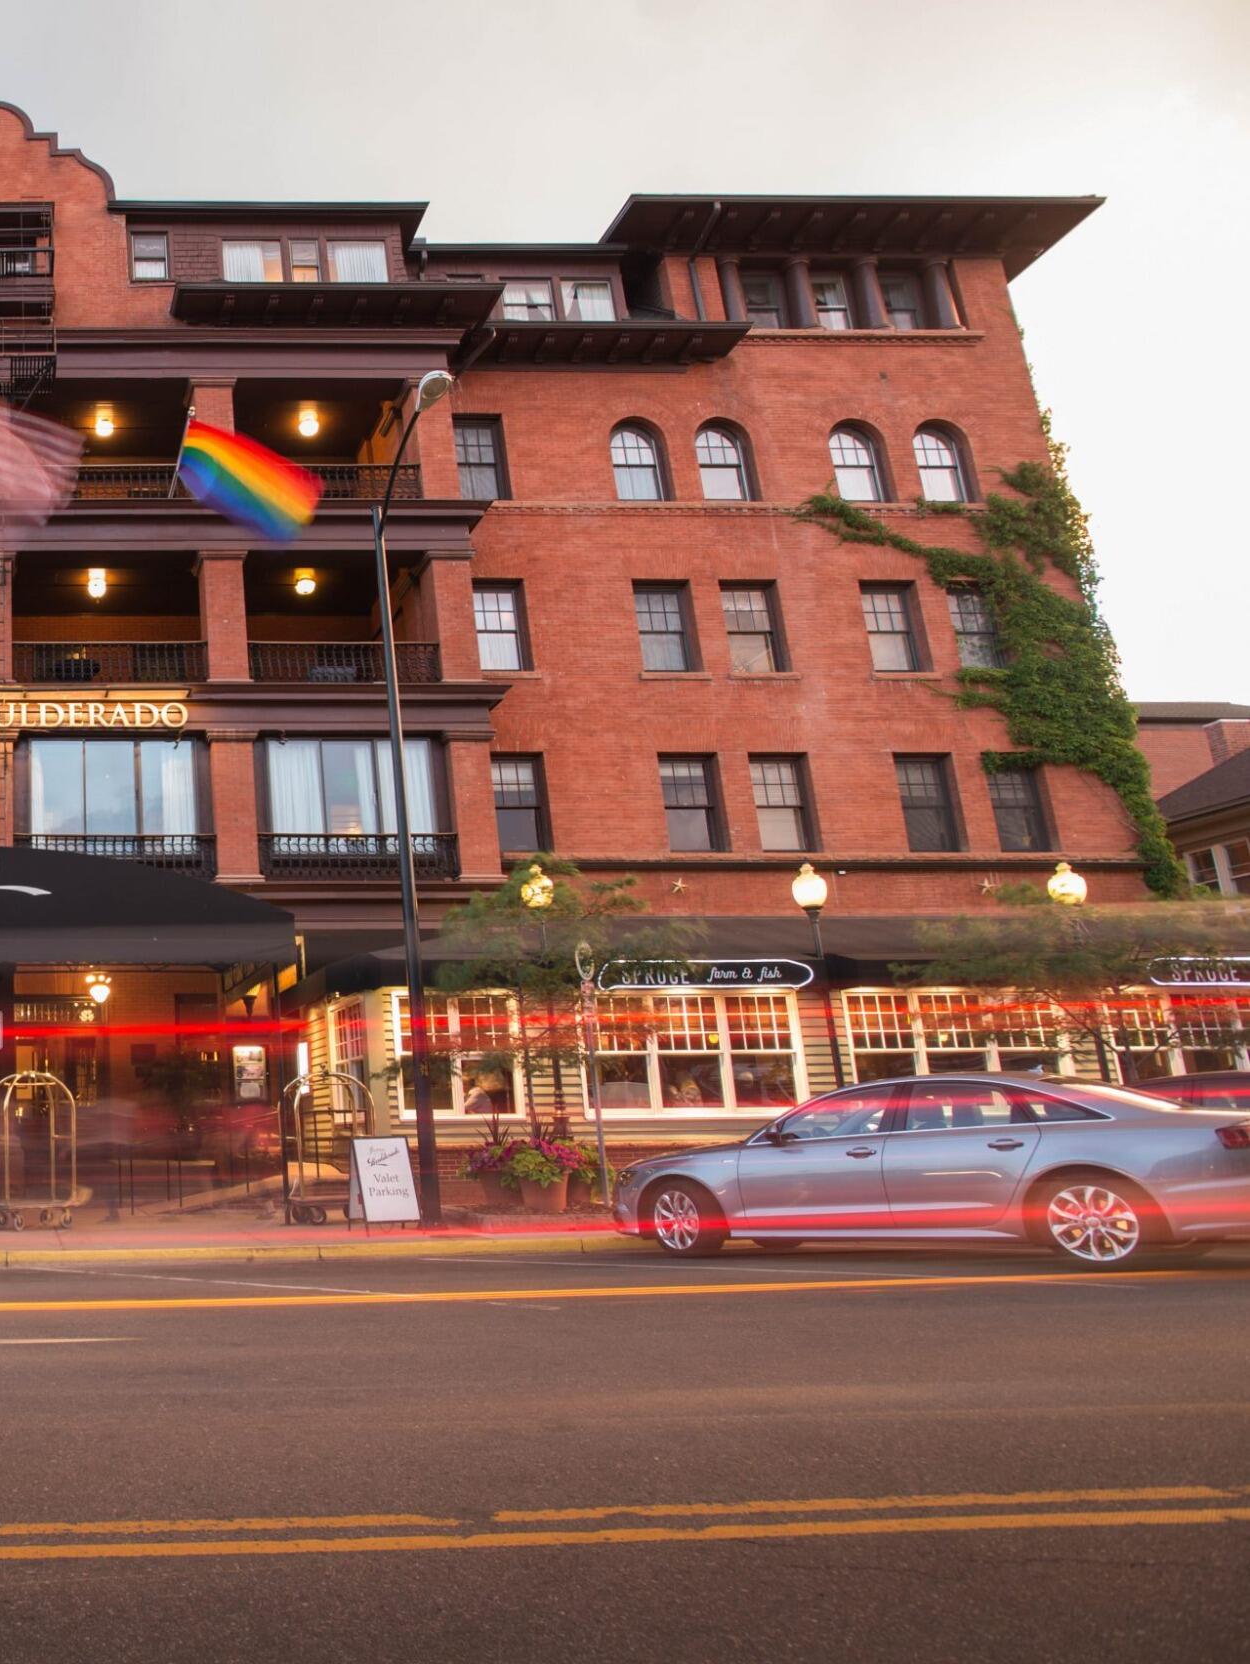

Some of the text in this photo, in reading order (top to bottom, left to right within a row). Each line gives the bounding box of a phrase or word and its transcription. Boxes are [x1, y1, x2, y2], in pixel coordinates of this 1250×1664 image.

[621, 966, 782, 985] SPRUCE farm & fish
[1171, 962, 1240, 982] SPRUCE
[373, 1173, 399, 1183] Valet
[369, 1187, 410, 1198] Parking
